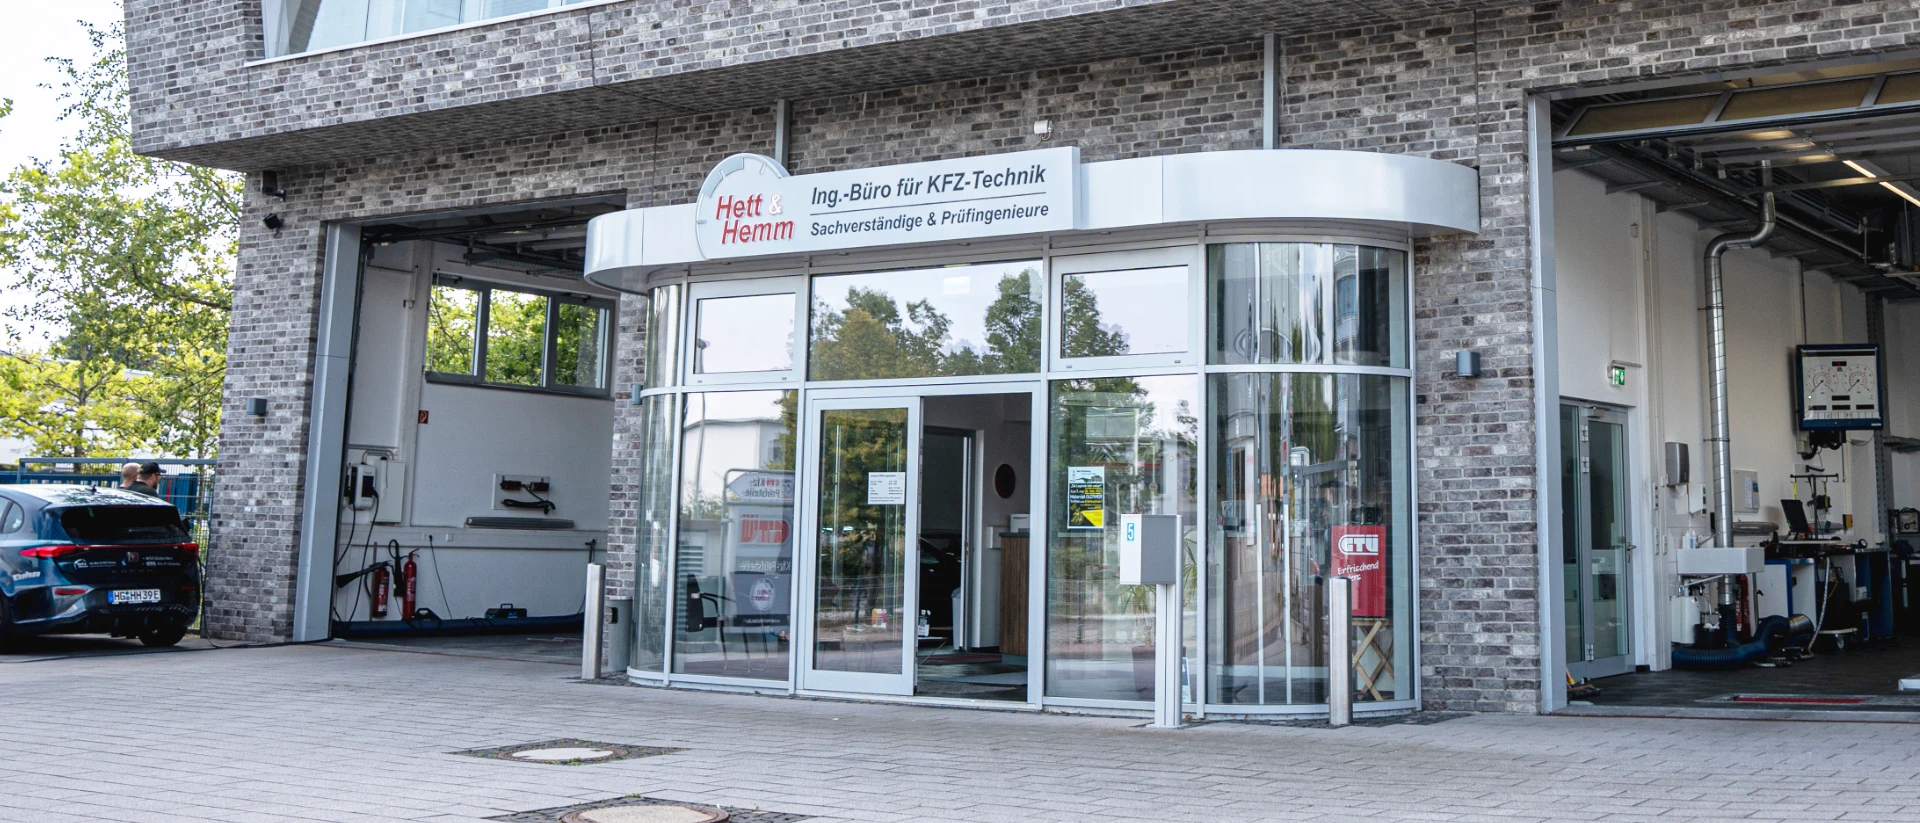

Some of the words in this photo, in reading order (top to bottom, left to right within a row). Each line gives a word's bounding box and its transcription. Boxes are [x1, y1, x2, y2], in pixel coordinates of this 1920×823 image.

[811, 182, 892, 208] Ing.-Büro
[896, 178, 924, 200] für
[927, 164, 1047, 195] KFZ-Technik
[715, 193, 762, 220] Hett
[768, 193, 784, 216] &
[721, 220, 794, 245] Hemm
[810, 216, 924, 237] Sachverständige
[927, 211, 938, 226] &
[941, 204, 1049, 226] Prüfingenieure
[1127, 523, 1135, 541] 5
[1338, 534, 1379, 556] GTÜ
[114, 591, 125, 600] HG
[130, 591, 141, 600] HH
